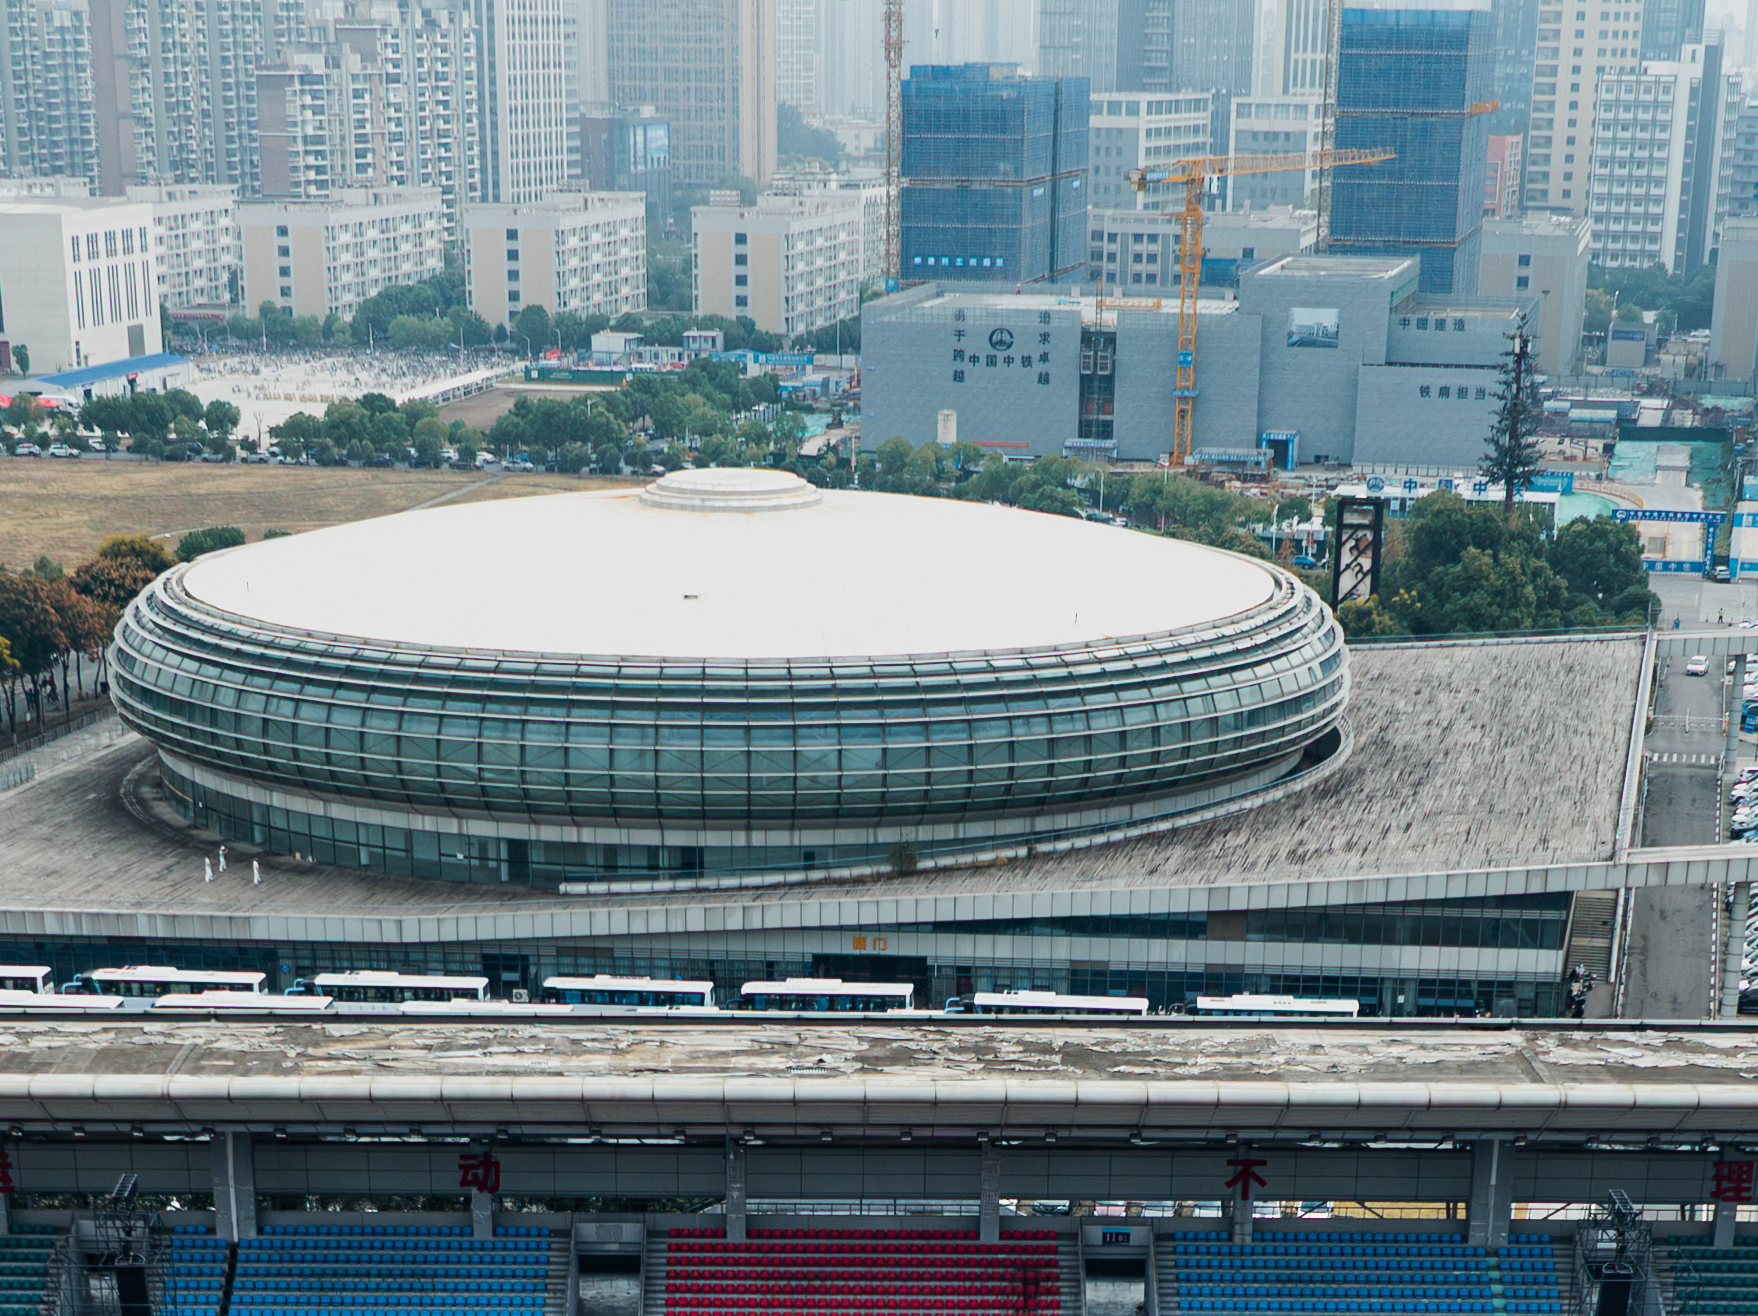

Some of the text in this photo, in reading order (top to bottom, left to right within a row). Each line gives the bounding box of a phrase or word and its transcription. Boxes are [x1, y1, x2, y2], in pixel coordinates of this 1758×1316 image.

[1399, 317, 1466, 332] 中国建造
[969, 353, 1033, 368] 中国中铁
[1419, 385, 1487, 400] 铁肩担当
[457, 1153, 502, 1195] 动
[1225, 1159, 1269, 1202] 不
[1711, 1160, 1755, 1203] 理
